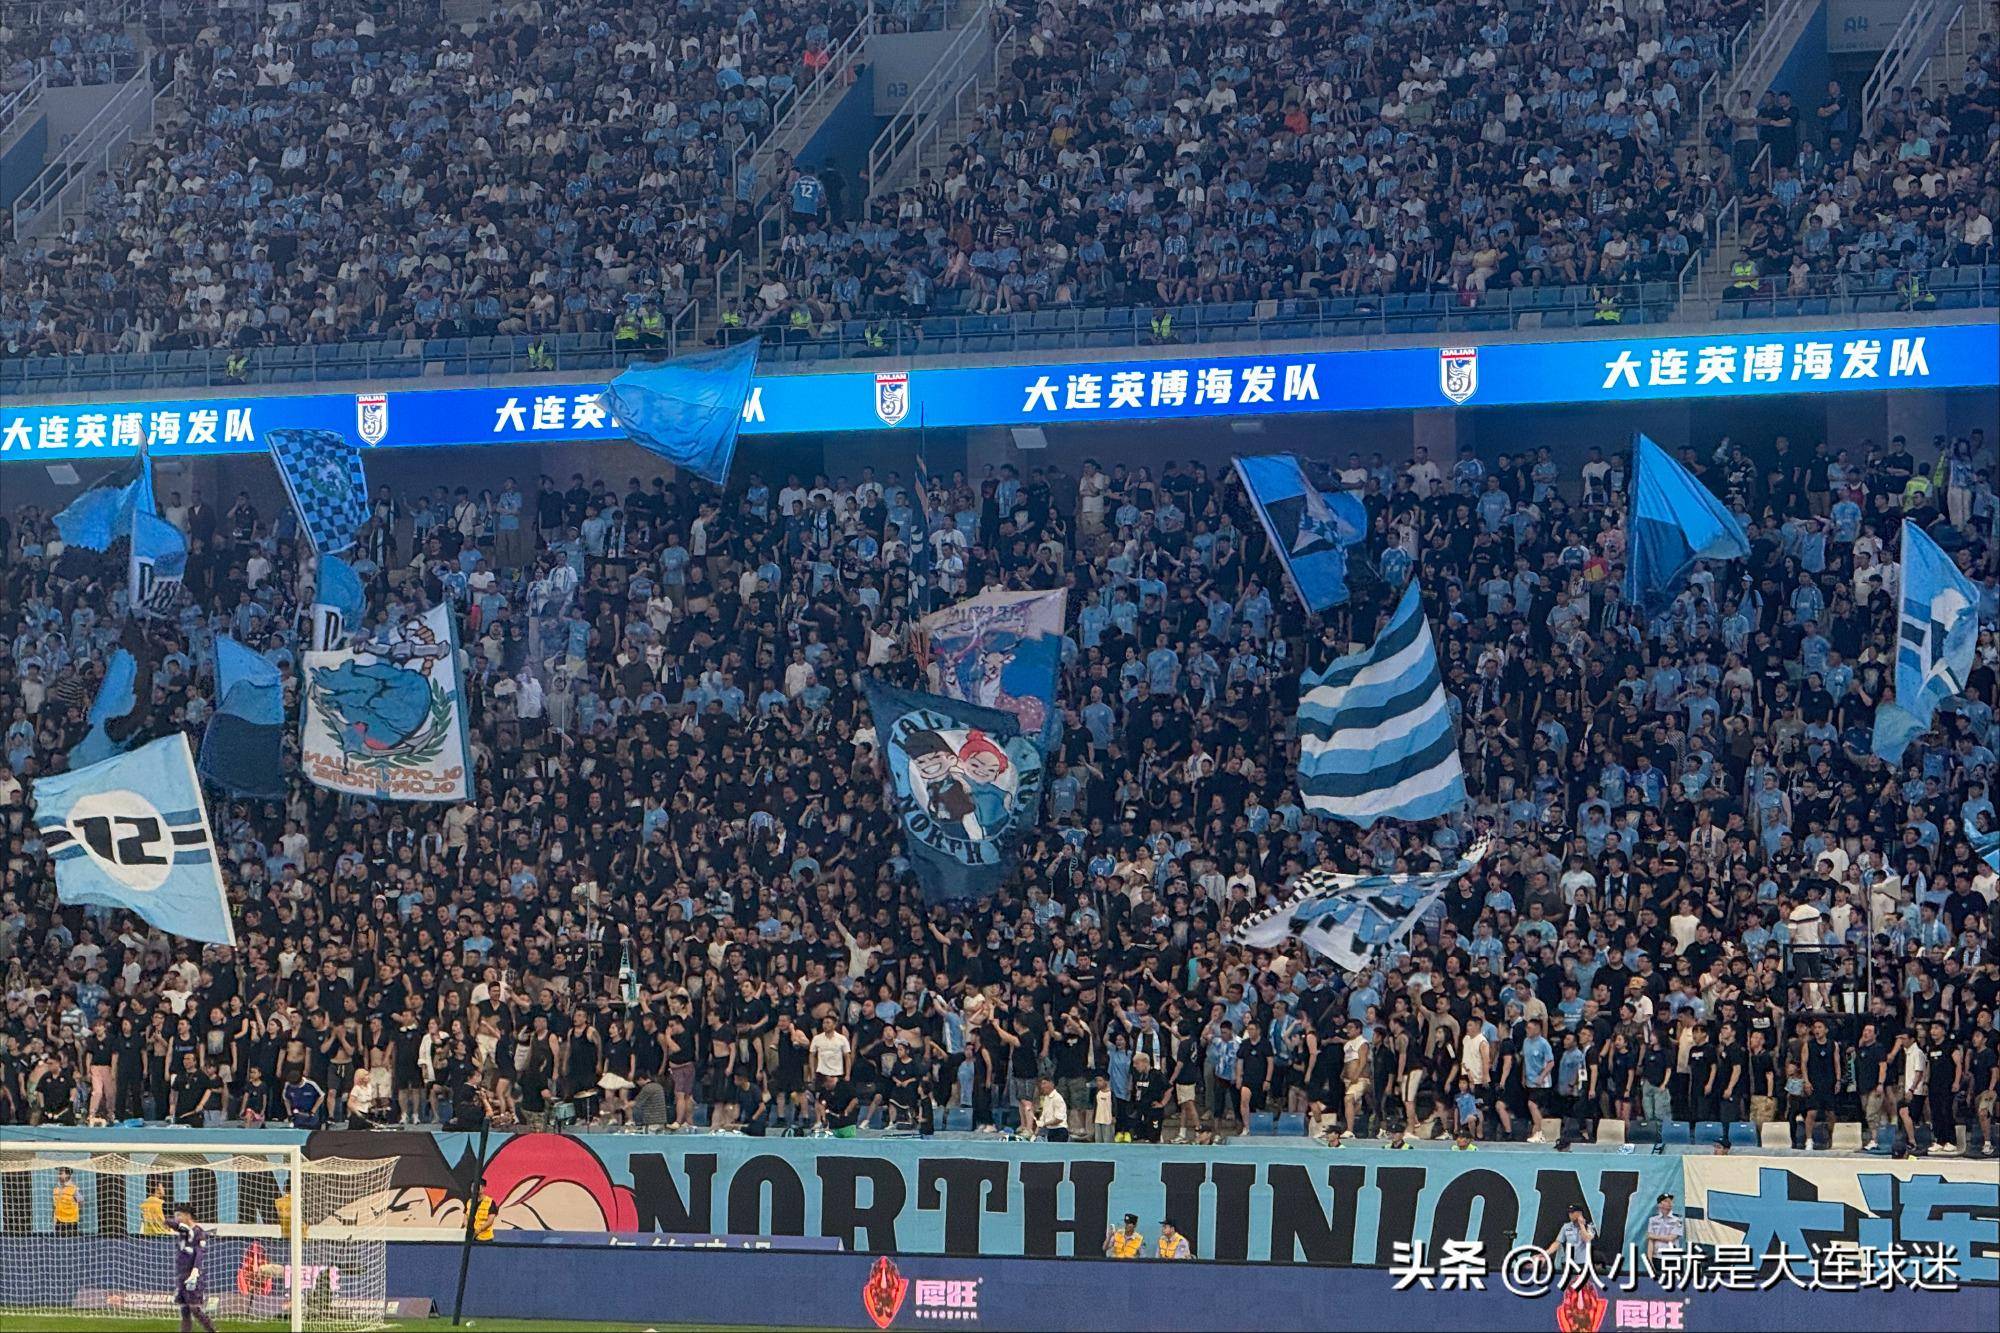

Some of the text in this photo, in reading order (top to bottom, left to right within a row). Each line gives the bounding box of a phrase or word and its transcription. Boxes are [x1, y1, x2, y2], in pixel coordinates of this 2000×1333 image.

[801, 184, 813, 198] 12
[1442, 348, 1475, 356] DALIAN
[1602, 336, 1930, 389] 大连英博海发队
[1022, 363, 1320, 412] 大连英博海发队
[1, 408, 255, 450] 大连英博海发队
[73, 816, 168, 865] 12
[629, 1153, 1639, 1267] NORTH UNION
